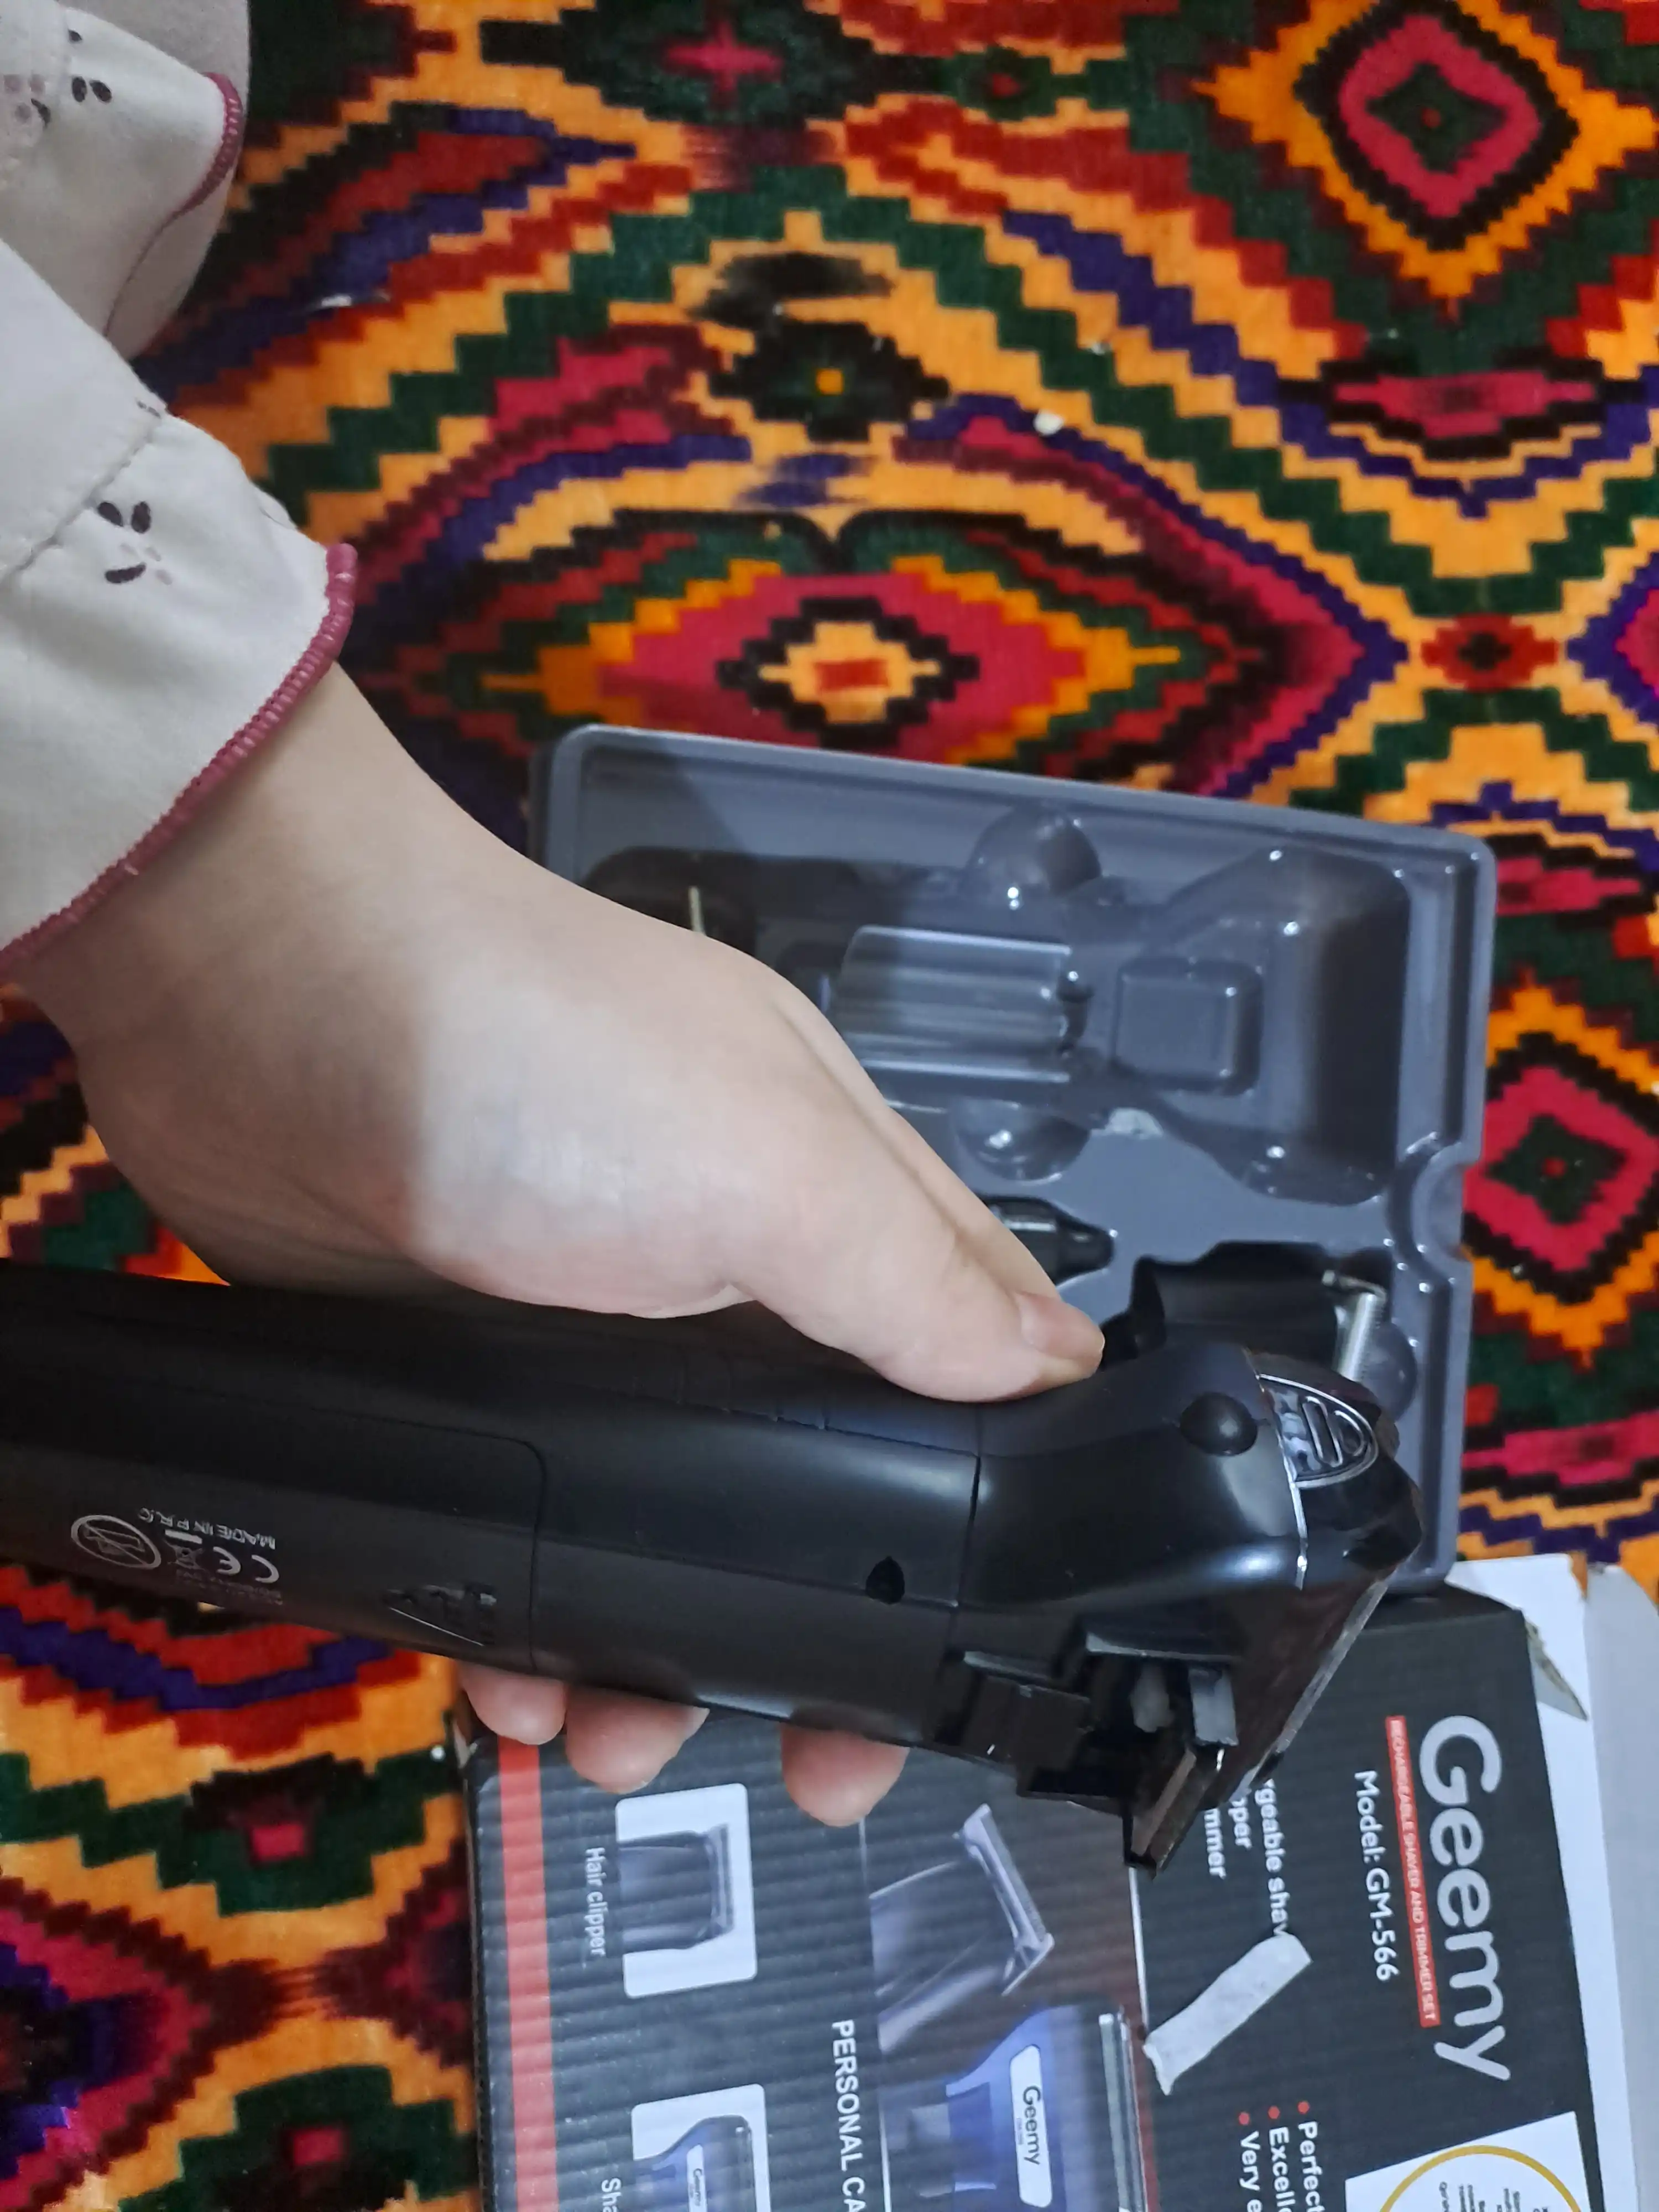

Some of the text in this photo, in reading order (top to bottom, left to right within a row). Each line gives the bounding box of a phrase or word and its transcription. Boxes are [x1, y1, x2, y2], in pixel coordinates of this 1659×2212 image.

[1204, 1808, 1227, 1880] mmer
[1354, 1770, 1400, 1981] Model: GM-566
[1390, 1719, 1437, 2021] RECHARGEABLE SHAVER AND TRIMMER SET
[1419, 1715, 1511, 2080] Geemy
[584, 1847, 608, 1957] Hair clipper
[832, 2019, 867, 2212] PERSONAL CA
[1022, 2085, 1042, 2166] Geemy
[1239, 2130, 1261, 2192] Very
[1269, 2126, 1296, 2212] Excell
